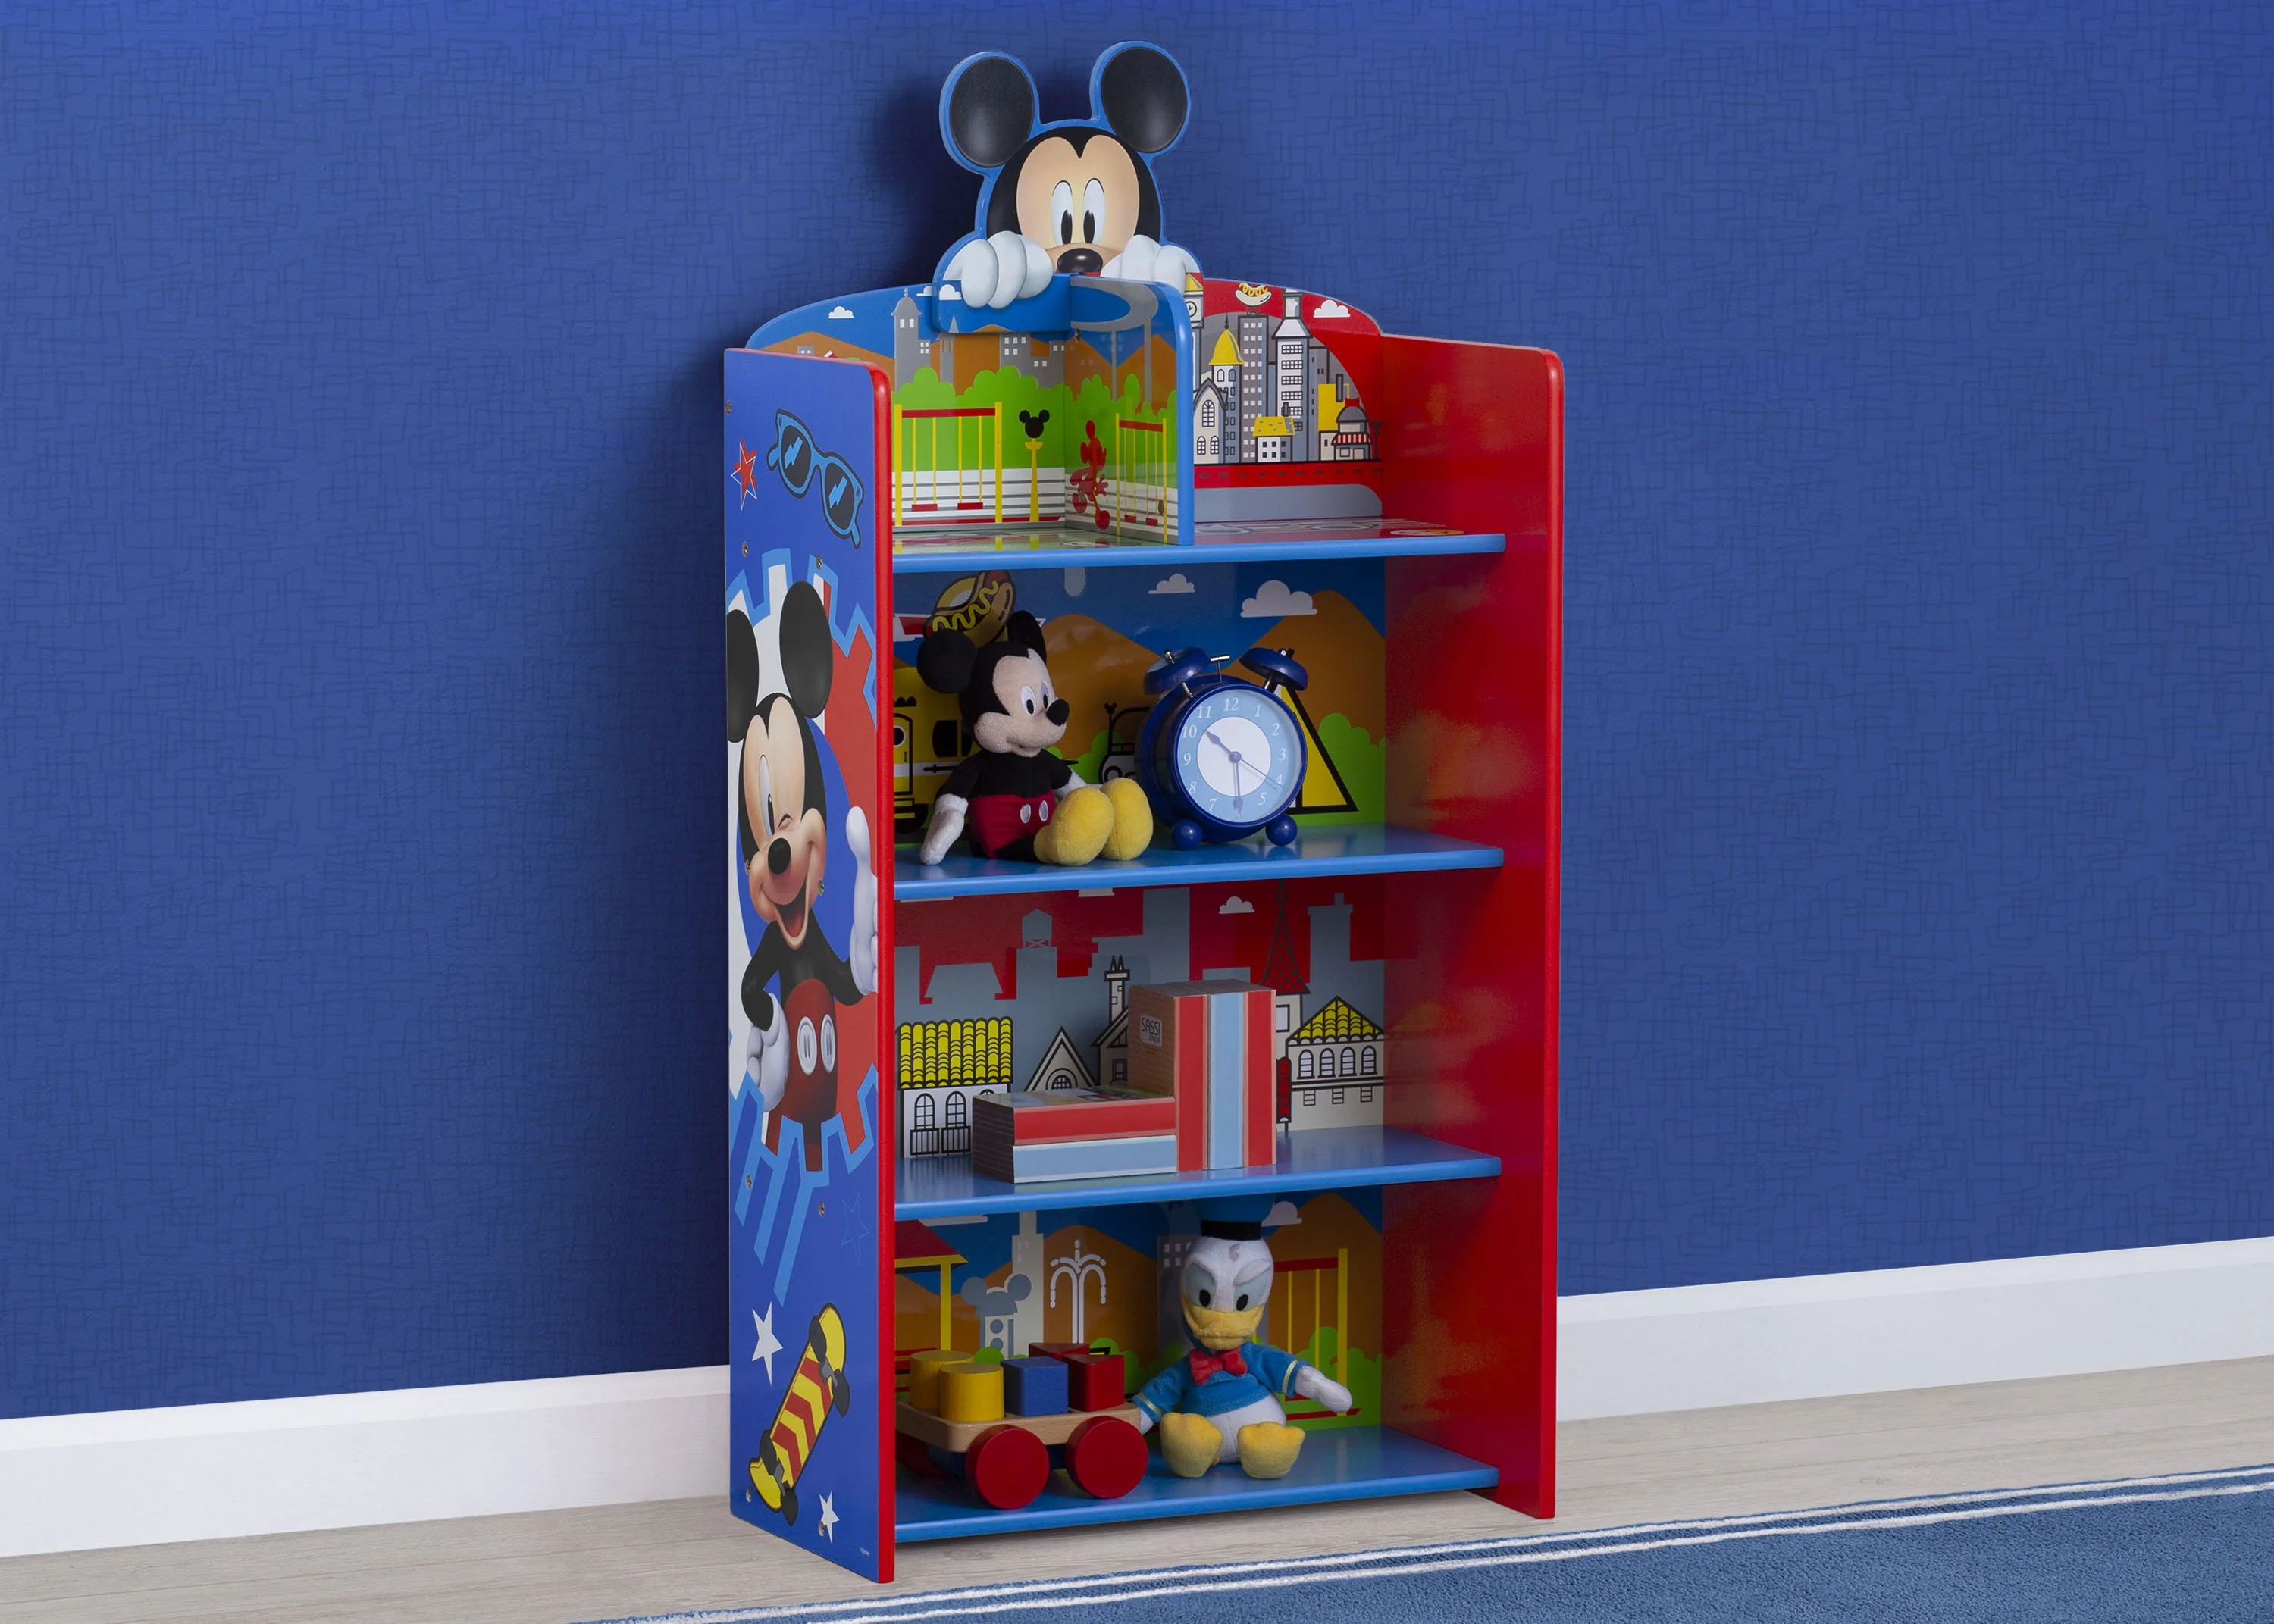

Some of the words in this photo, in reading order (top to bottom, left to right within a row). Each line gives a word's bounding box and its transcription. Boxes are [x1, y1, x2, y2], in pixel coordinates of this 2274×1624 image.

[1223, 697, 1239, 712] 12
[1254, 703, 1261, 717] 1
[1196, 705, 1212, 719] 11
[1181, 724, 1197, 739] 10
[1271, 722, 1280, 736] 2
[1182, 752, 1192, 767] 9
[1278, 747, 1286, 762] 3
[1275, 773, 1283, 787] 4
[1188, 781, 1197, 795] 8
[1208, 798, 1217, 812] 7
[1258, 791, 1267, 806] 5
[1142, 1017, 1161, 1037] SASSI
